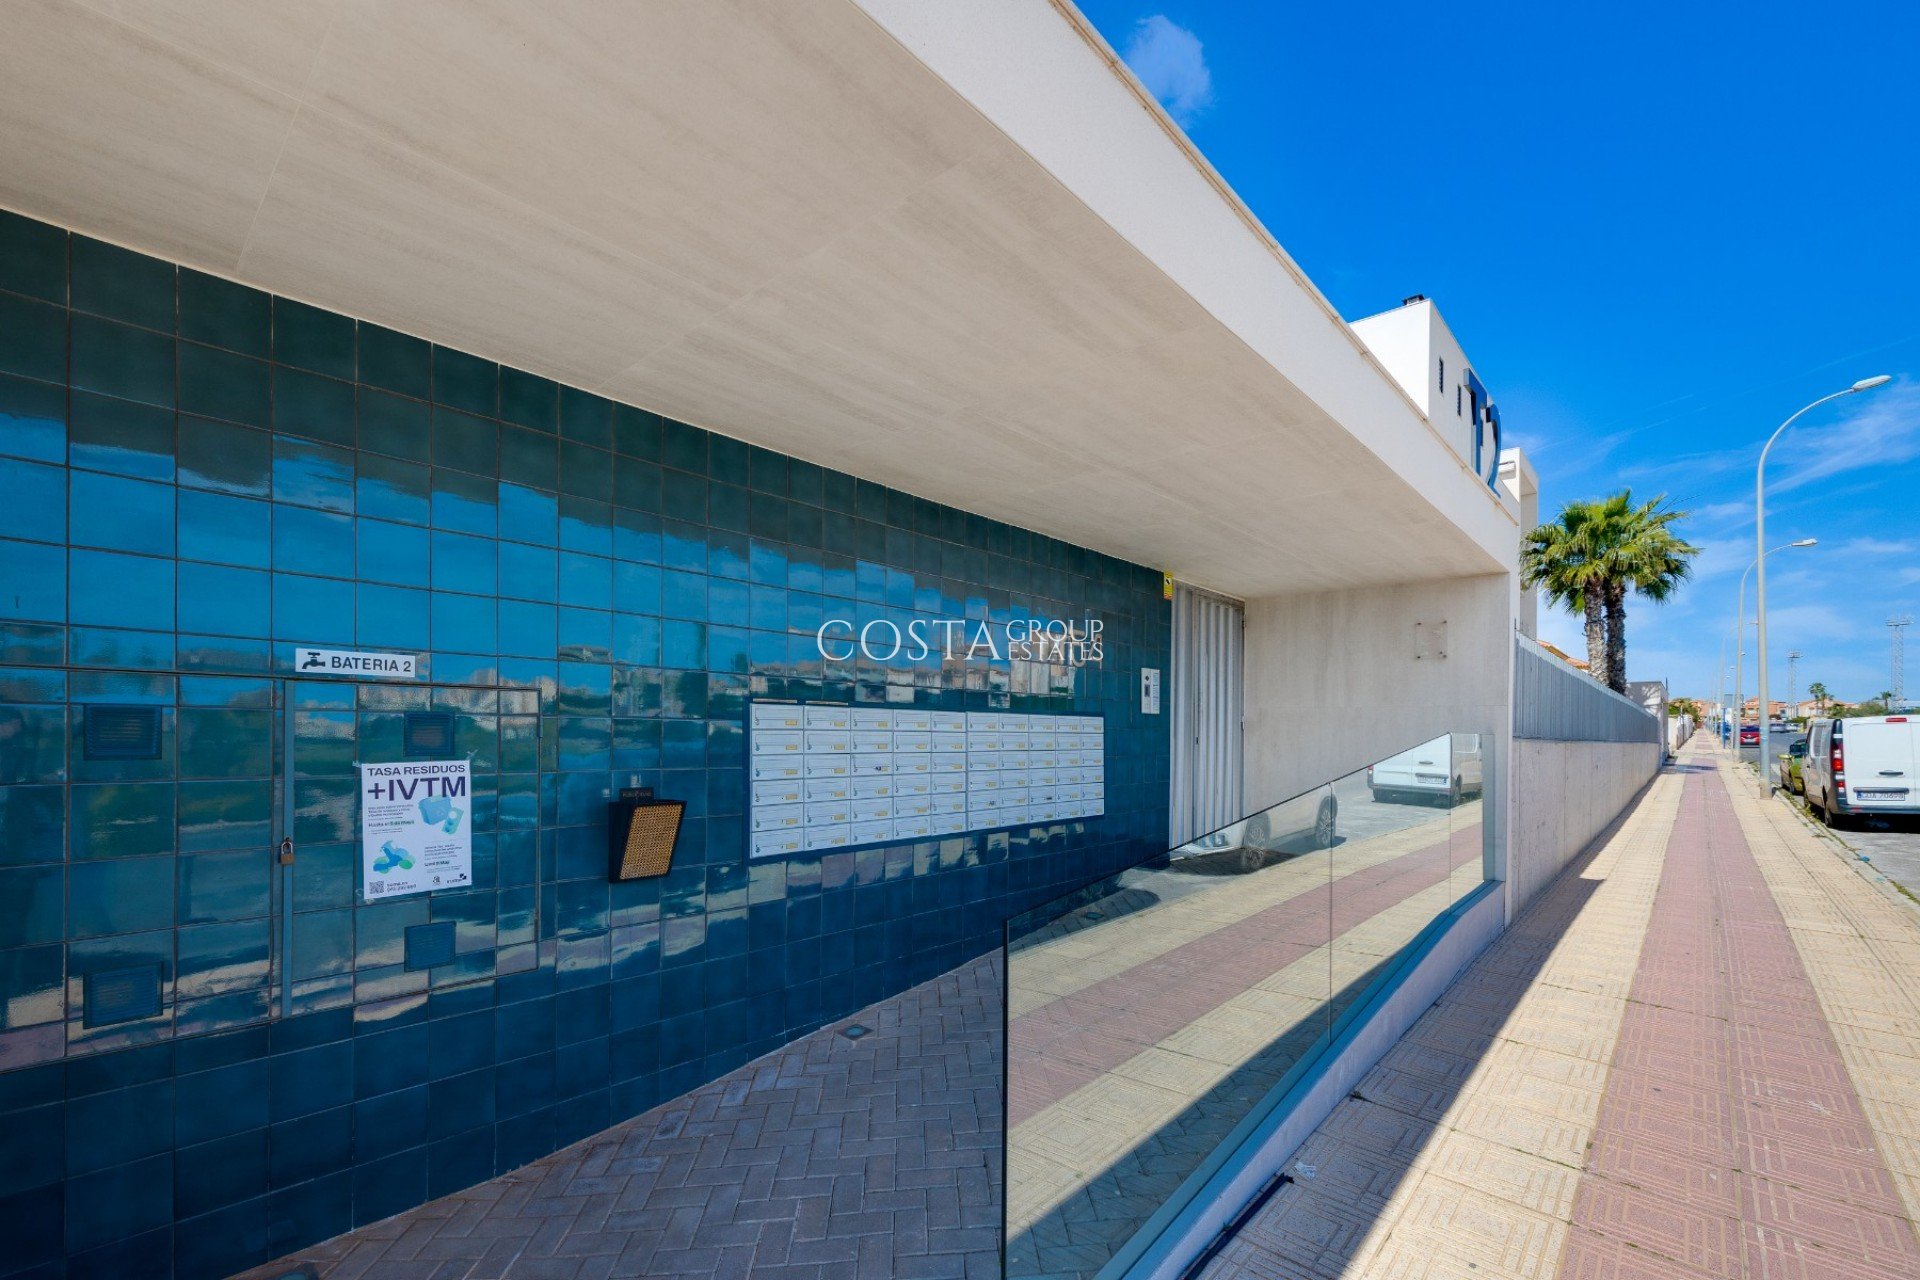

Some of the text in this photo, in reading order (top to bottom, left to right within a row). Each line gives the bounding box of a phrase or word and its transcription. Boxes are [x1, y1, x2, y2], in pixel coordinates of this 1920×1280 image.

[331, 656, 412, 672] BATERIA 2
[367, 764, 466, 777] TASA RESIDUOS
[367, 776, 466, 801] +IVTM
